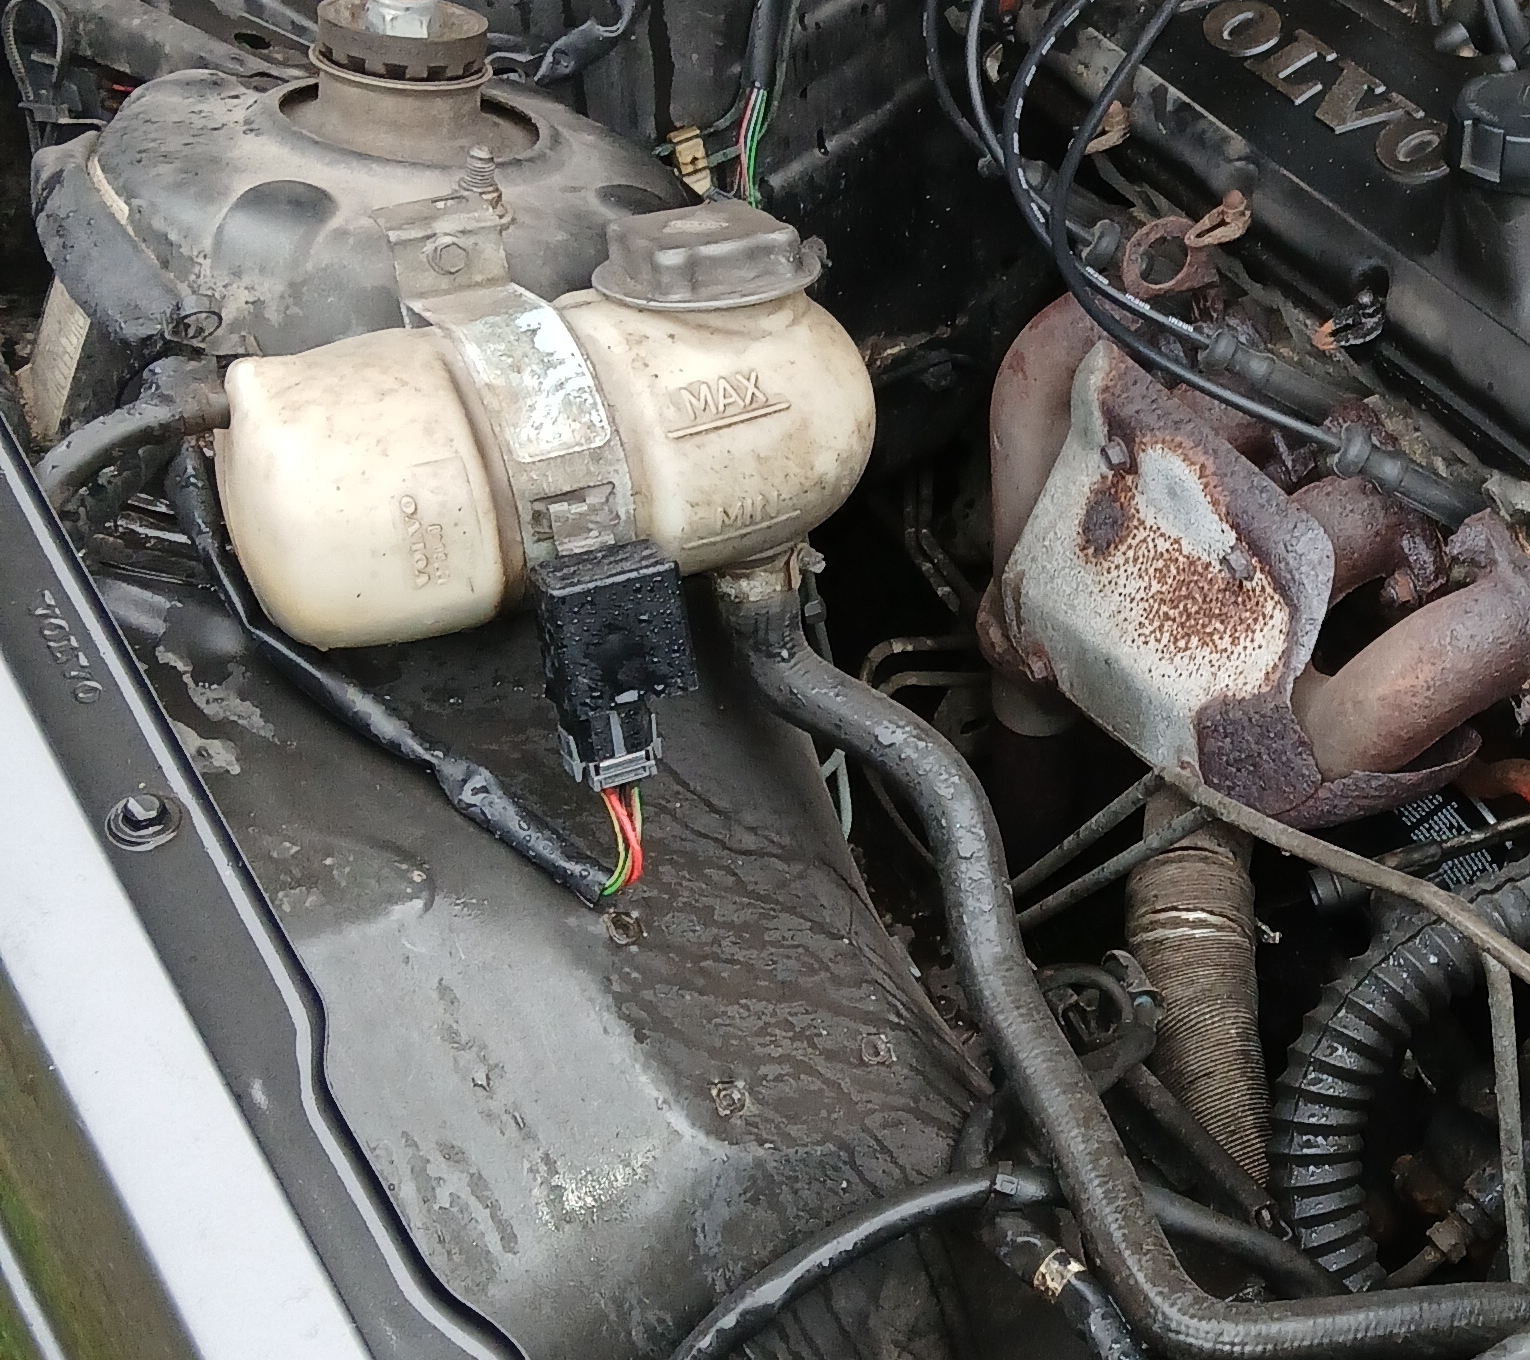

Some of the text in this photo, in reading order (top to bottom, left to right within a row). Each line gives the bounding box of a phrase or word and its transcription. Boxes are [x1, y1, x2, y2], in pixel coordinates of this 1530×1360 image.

[680, 368, 769, 421] MAX
[399, 494, 431, 590] VOLVO
[717, 490, 781, 533] MIN
[28, 590, 103, 704] VOLVO
